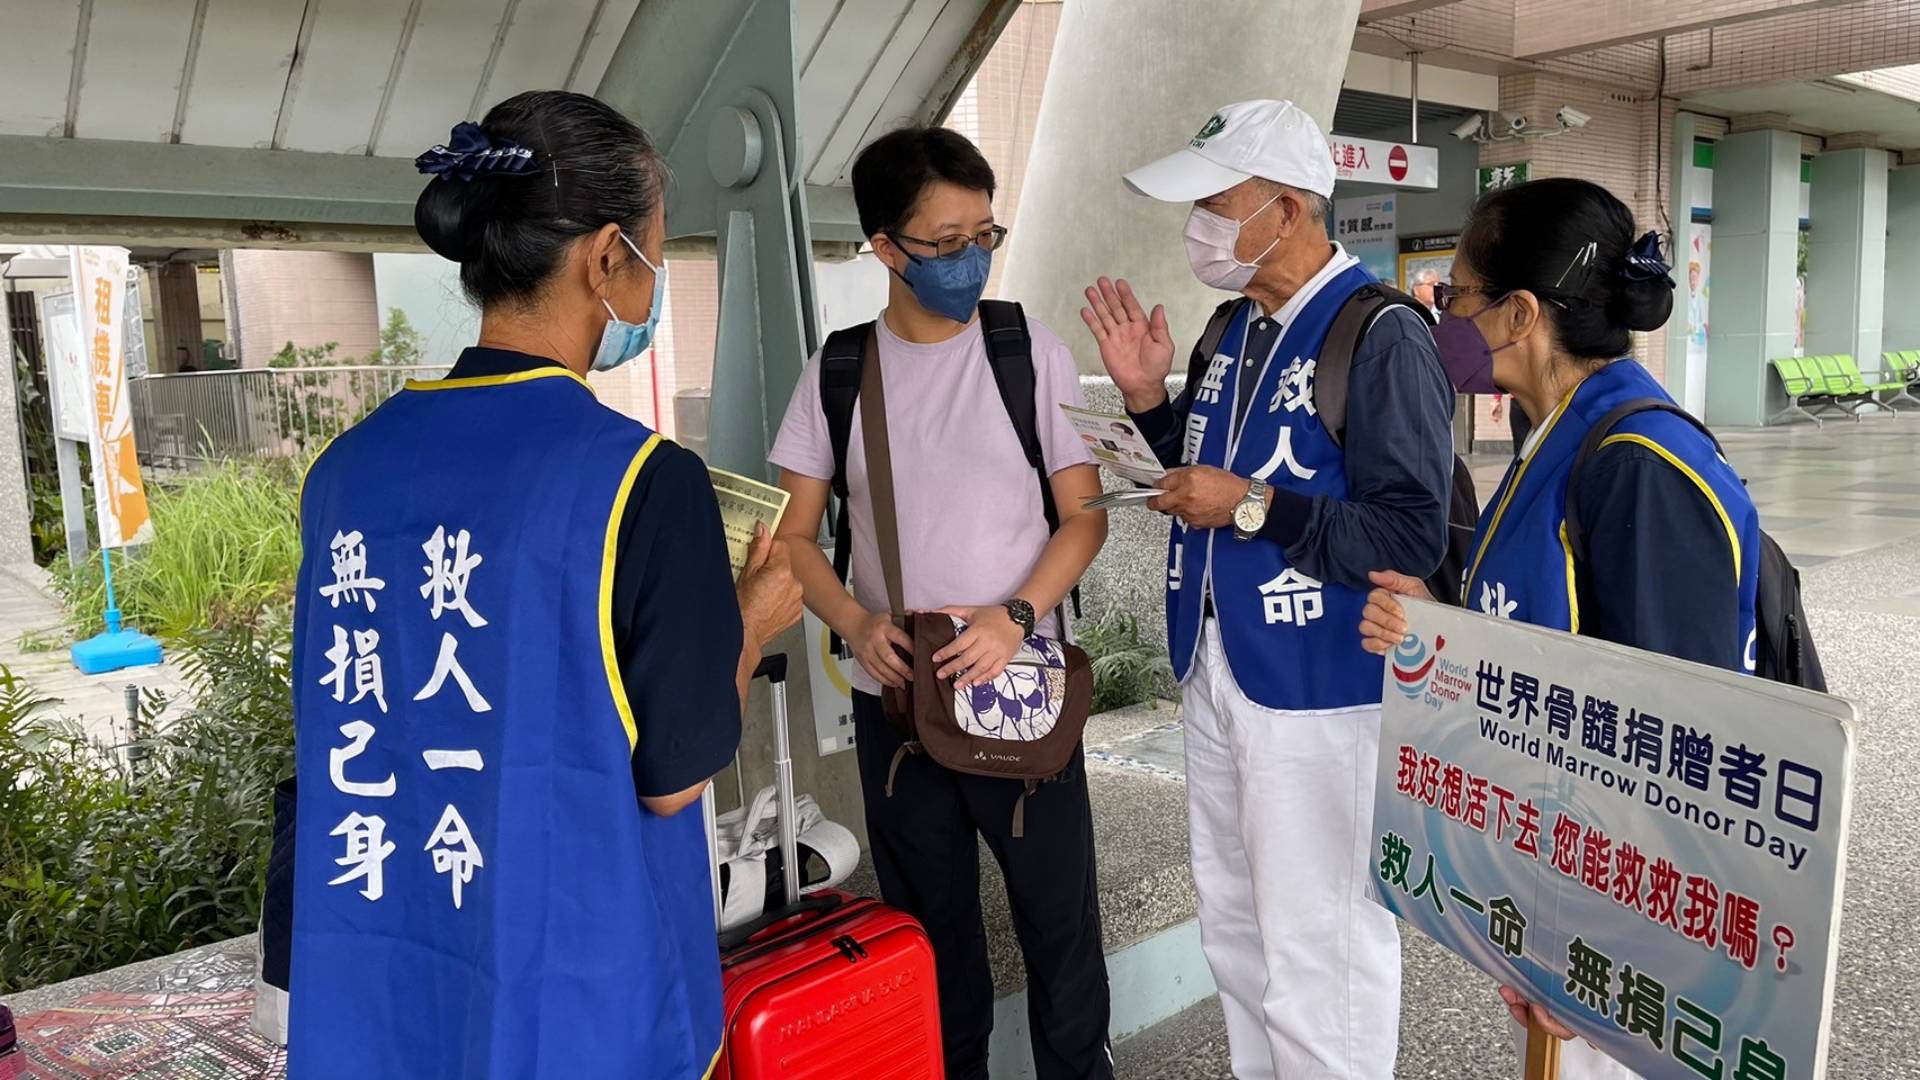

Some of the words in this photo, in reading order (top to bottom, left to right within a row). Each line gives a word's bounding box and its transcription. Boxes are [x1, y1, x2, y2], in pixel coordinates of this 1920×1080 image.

[318, 530, 397, 901] 無損己身
[413, 525, 493, 909] 救人一命
[1424, 692, 1444, 712] Day
[1431, 681, 1460, 702] Donor
[1435, 669, 1472, 692] Marrow
[1440, 657, 1468, 677] World
[1397, 746, 1540, 859] 我好想活下去
[1475, 659, 1823, 832] 世界骨髓捐贈者日
[1480, 716, 1541, 759] World
[1546, 742, 1638, 797] Marrow
[1645, 781, 1736, 836] Donor
[1744, 819, 1808, 871] Day
[1380, 832, 1527, 956] 救人一命
